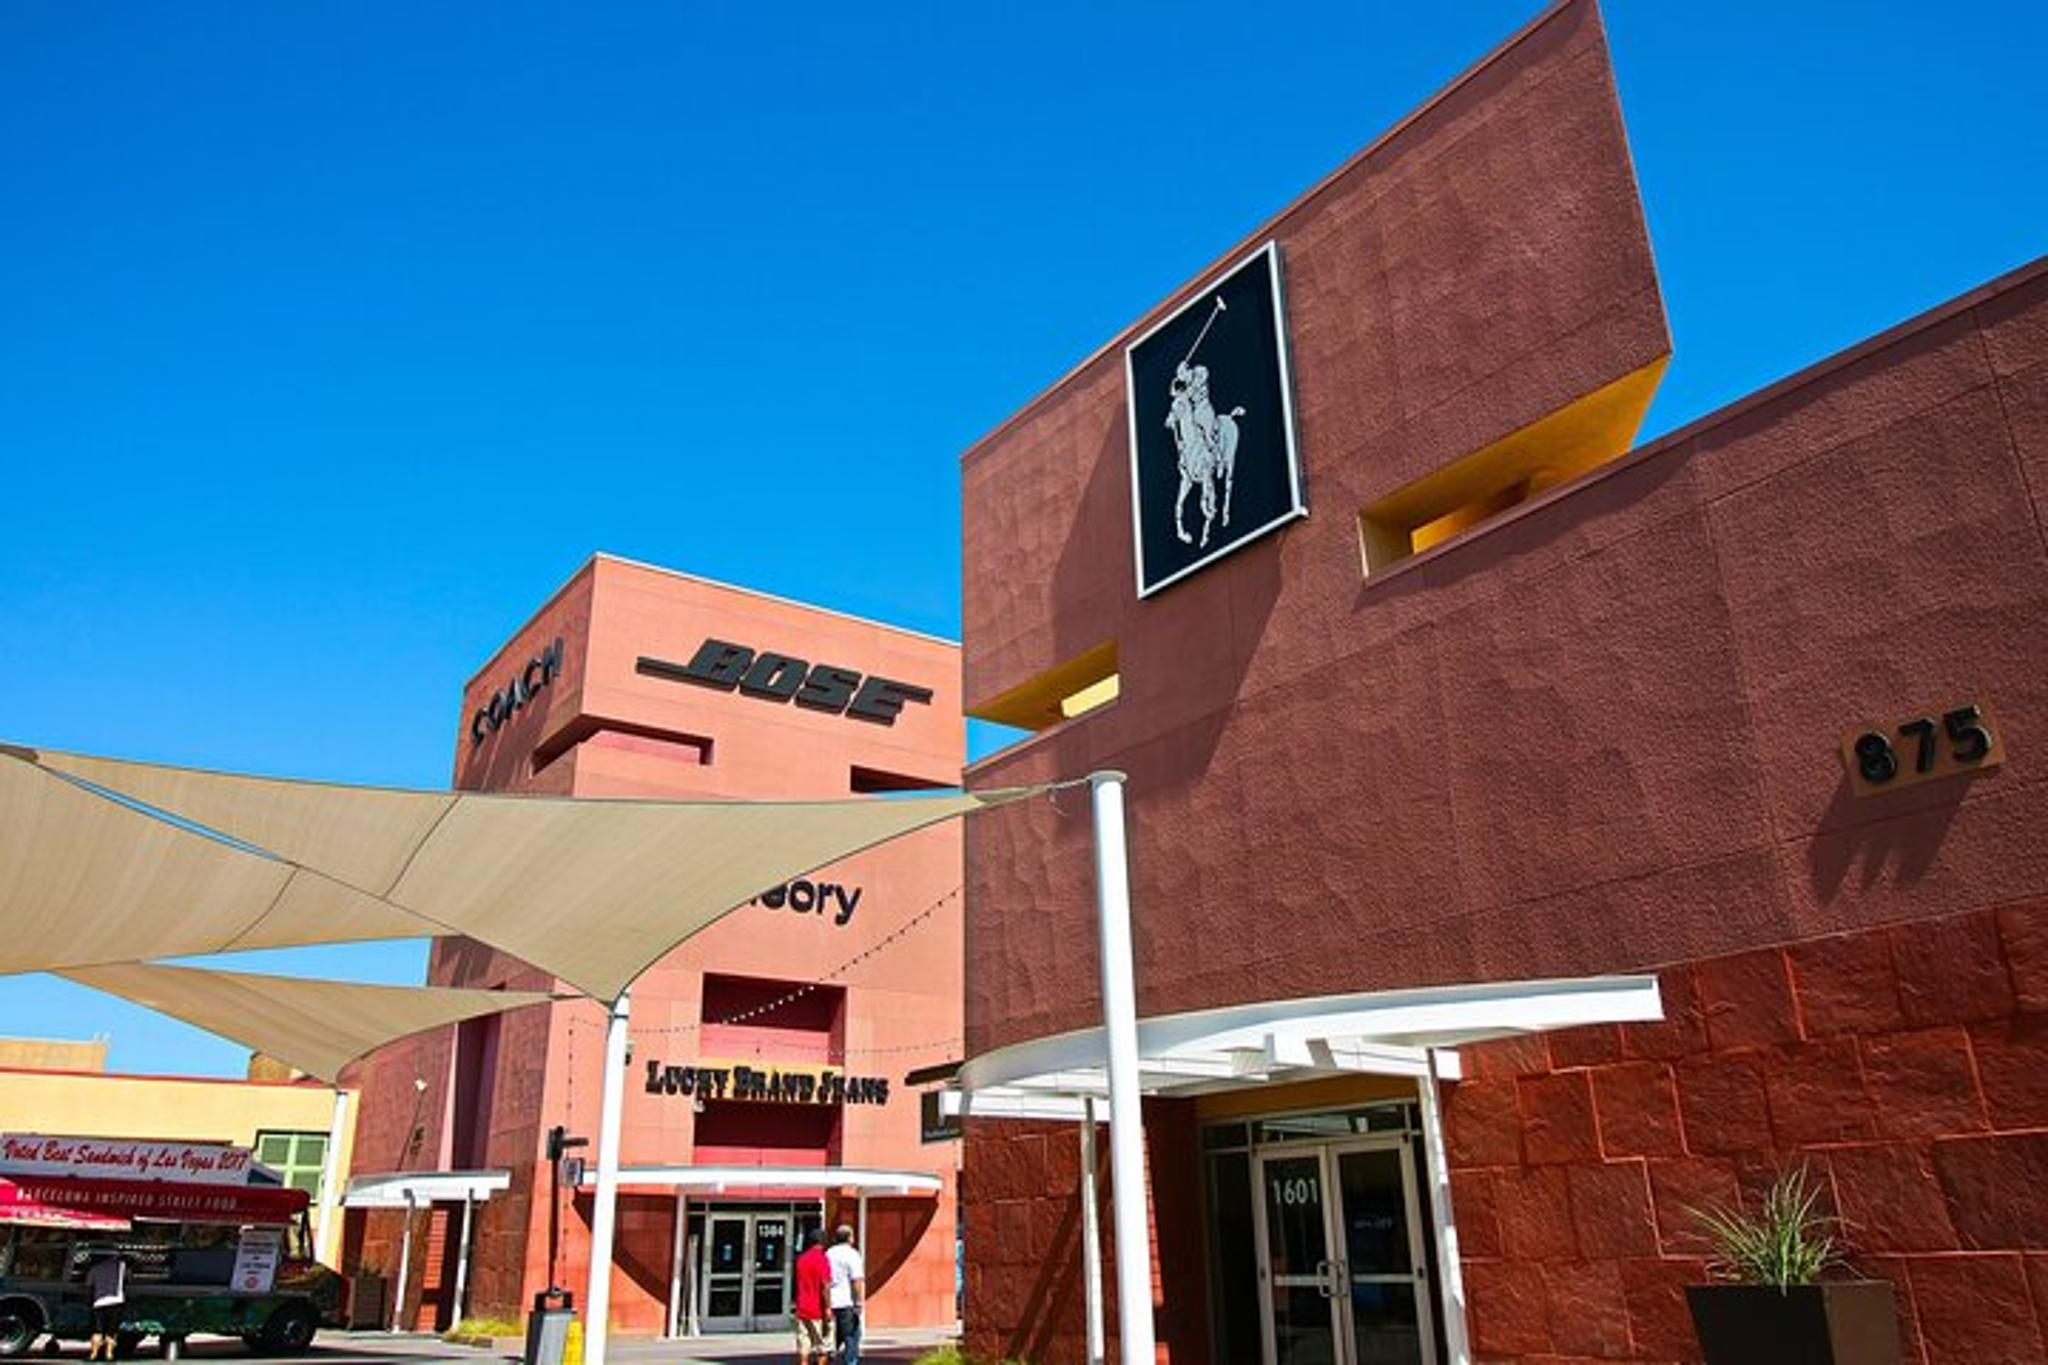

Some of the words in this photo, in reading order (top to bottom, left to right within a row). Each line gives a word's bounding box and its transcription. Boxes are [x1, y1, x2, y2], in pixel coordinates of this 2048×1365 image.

[472, 636, 564, 748] COACH
[635, 638, 933, 727] BOSE
[1854, 704, 1993, 784] 875
[43, 1140, 74, 1161] Best
[74, 1144, 136, 1165] Sandwich
[137, 1148, 153, 1172] of
[153, 1148, 177, 1167] Las
[181, 1149, 214, 1175] Vegas
[1273, 1178, 1318, 1205] 1601
